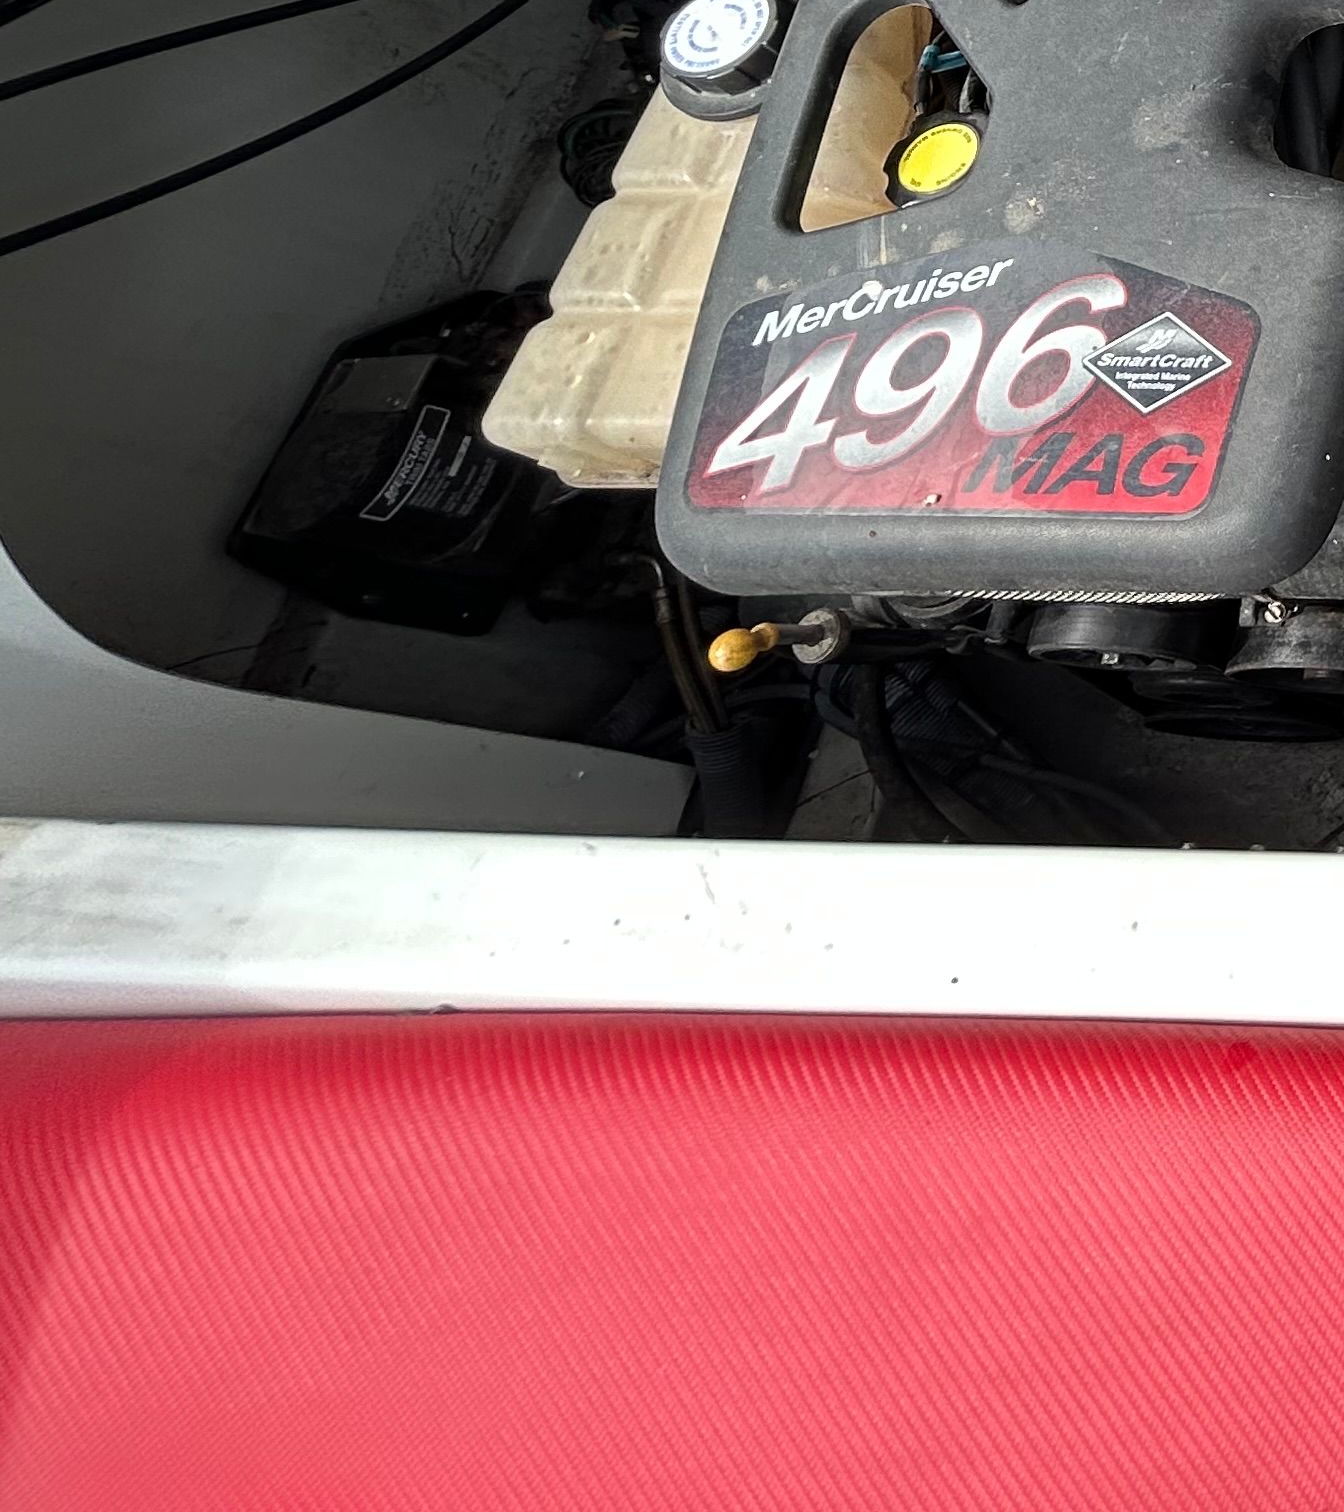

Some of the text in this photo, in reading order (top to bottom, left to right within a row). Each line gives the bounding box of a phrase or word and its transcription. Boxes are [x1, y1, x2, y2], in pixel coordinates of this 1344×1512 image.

[752, 255, 1014, 347] MerCruiser
[702, 273, 1128, 495] 496
[1097, 353, 1214, 368] SmartCraft
[962, 432, 1207, 498] MAG
